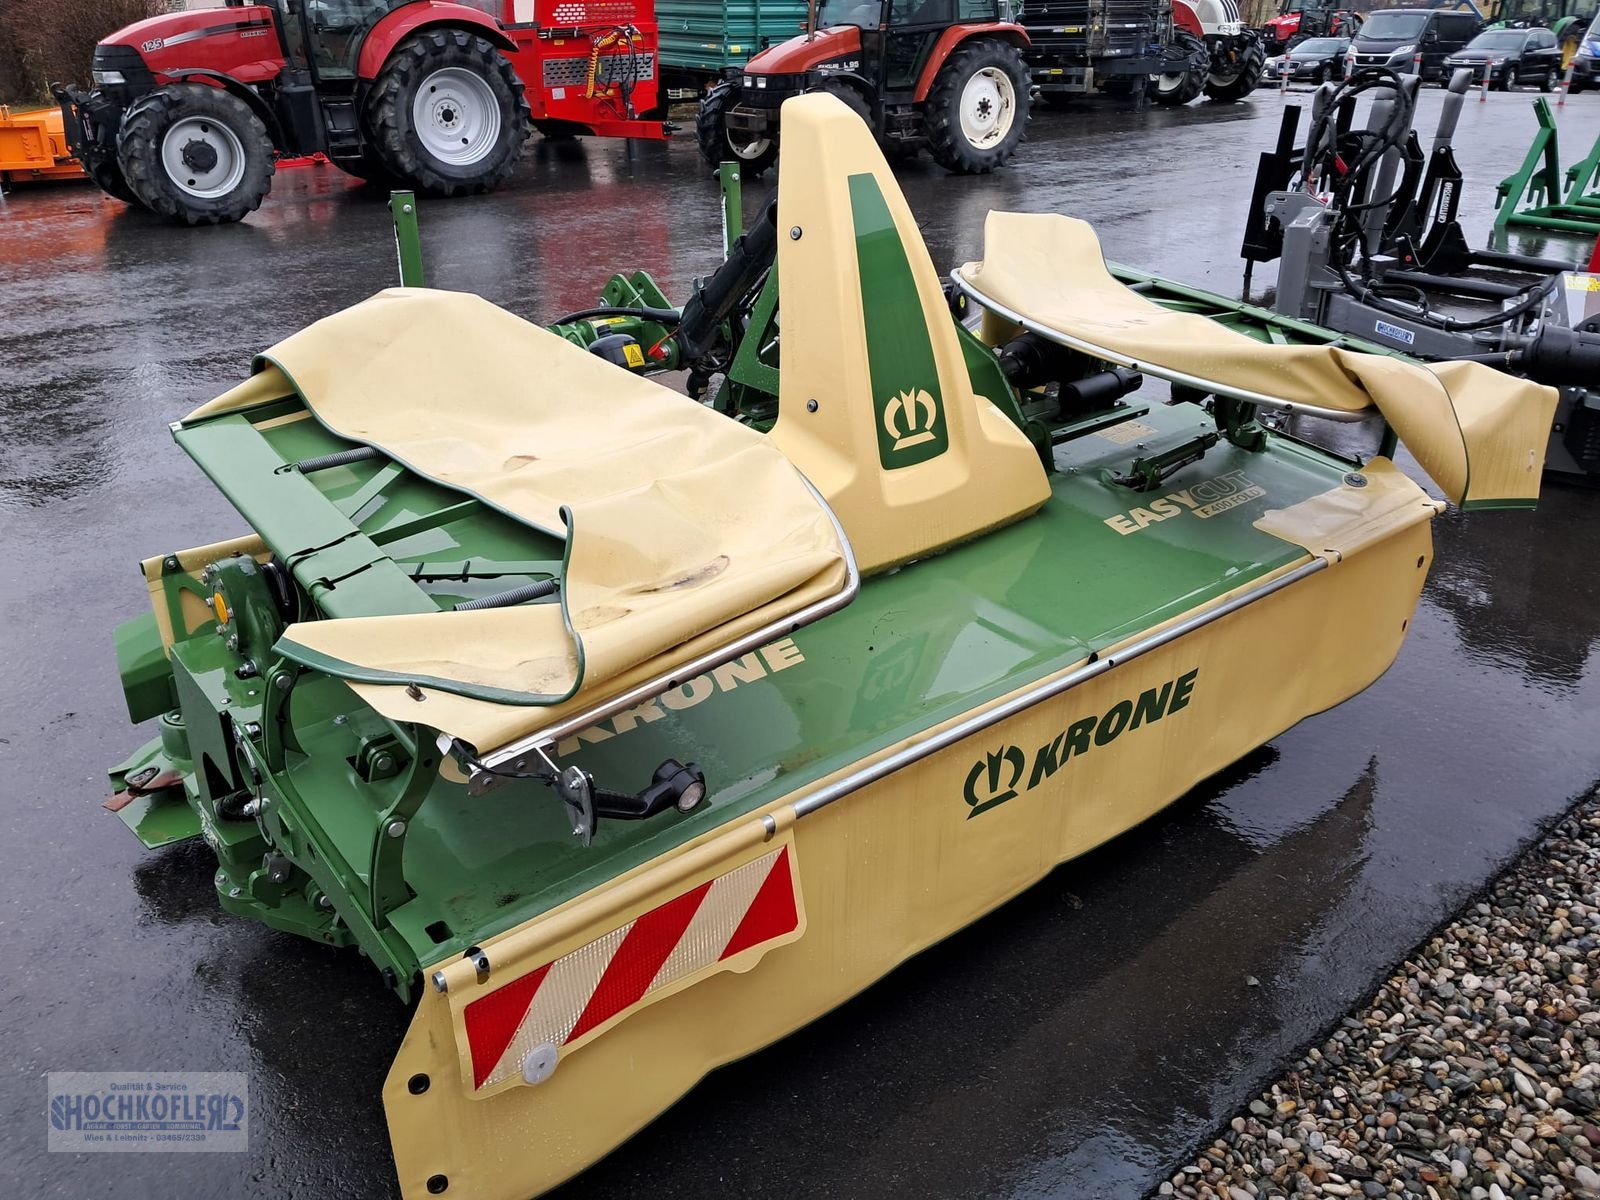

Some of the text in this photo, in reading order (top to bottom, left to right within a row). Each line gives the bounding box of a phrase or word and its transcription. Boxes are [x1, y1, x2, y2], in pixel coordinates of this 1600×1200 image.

[142, 38, 162, 52] 125
[1103, 469, 1256, 536] EASYCUT
[1200, 488, 1261, 516] F 400 FOLD
[1026, 667, 1199, 791] KRONE
